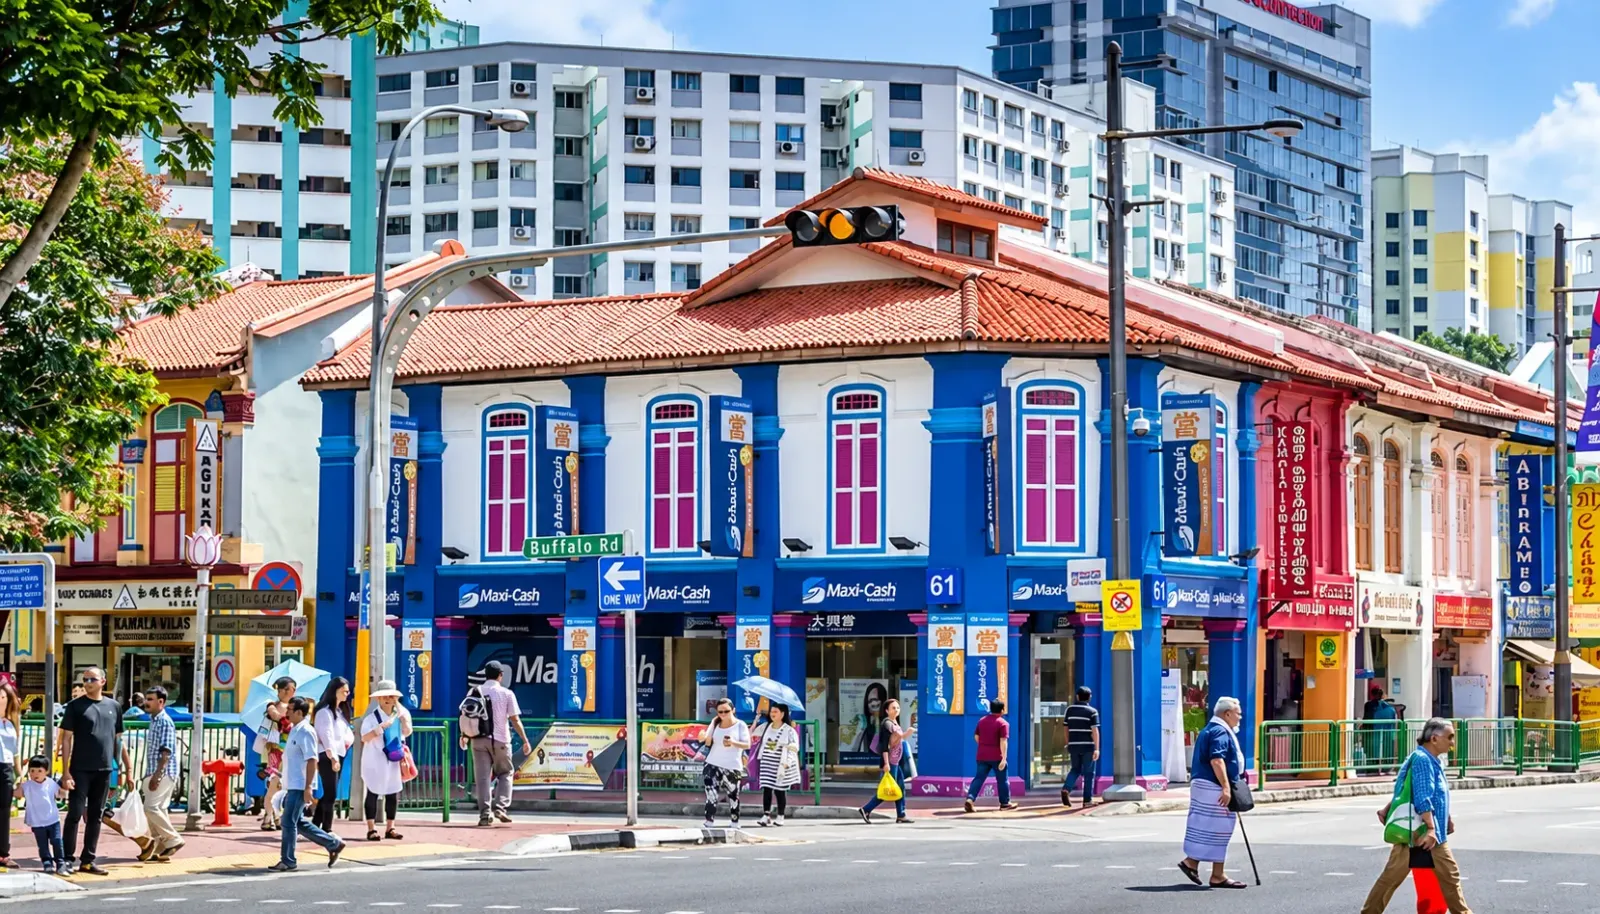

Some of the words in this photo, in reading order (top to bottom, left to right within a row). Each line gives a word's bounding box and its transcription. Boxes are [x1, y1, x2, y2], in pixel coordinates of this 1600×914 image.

[530, 538, 592, 555] Buffalo
[600, 537, 618, 552] Rd
[647, 585, 711, 600] Maxi-Cash
[826, 582, 897, 597] Maxi-Cash
[930, 574, 955, 597] 61
[1033, 583, 1068, 596] Maxi-
[1153, 580, 1166, 601] 61
[480, 587, 540, 602] Maxi-Cash
[604, 594, 621, 606] ONE
[624, 593, 642, 605] WAY
[113, 617, 158, 630] KAMALA
[160, 616, 191, 630] VILAS
